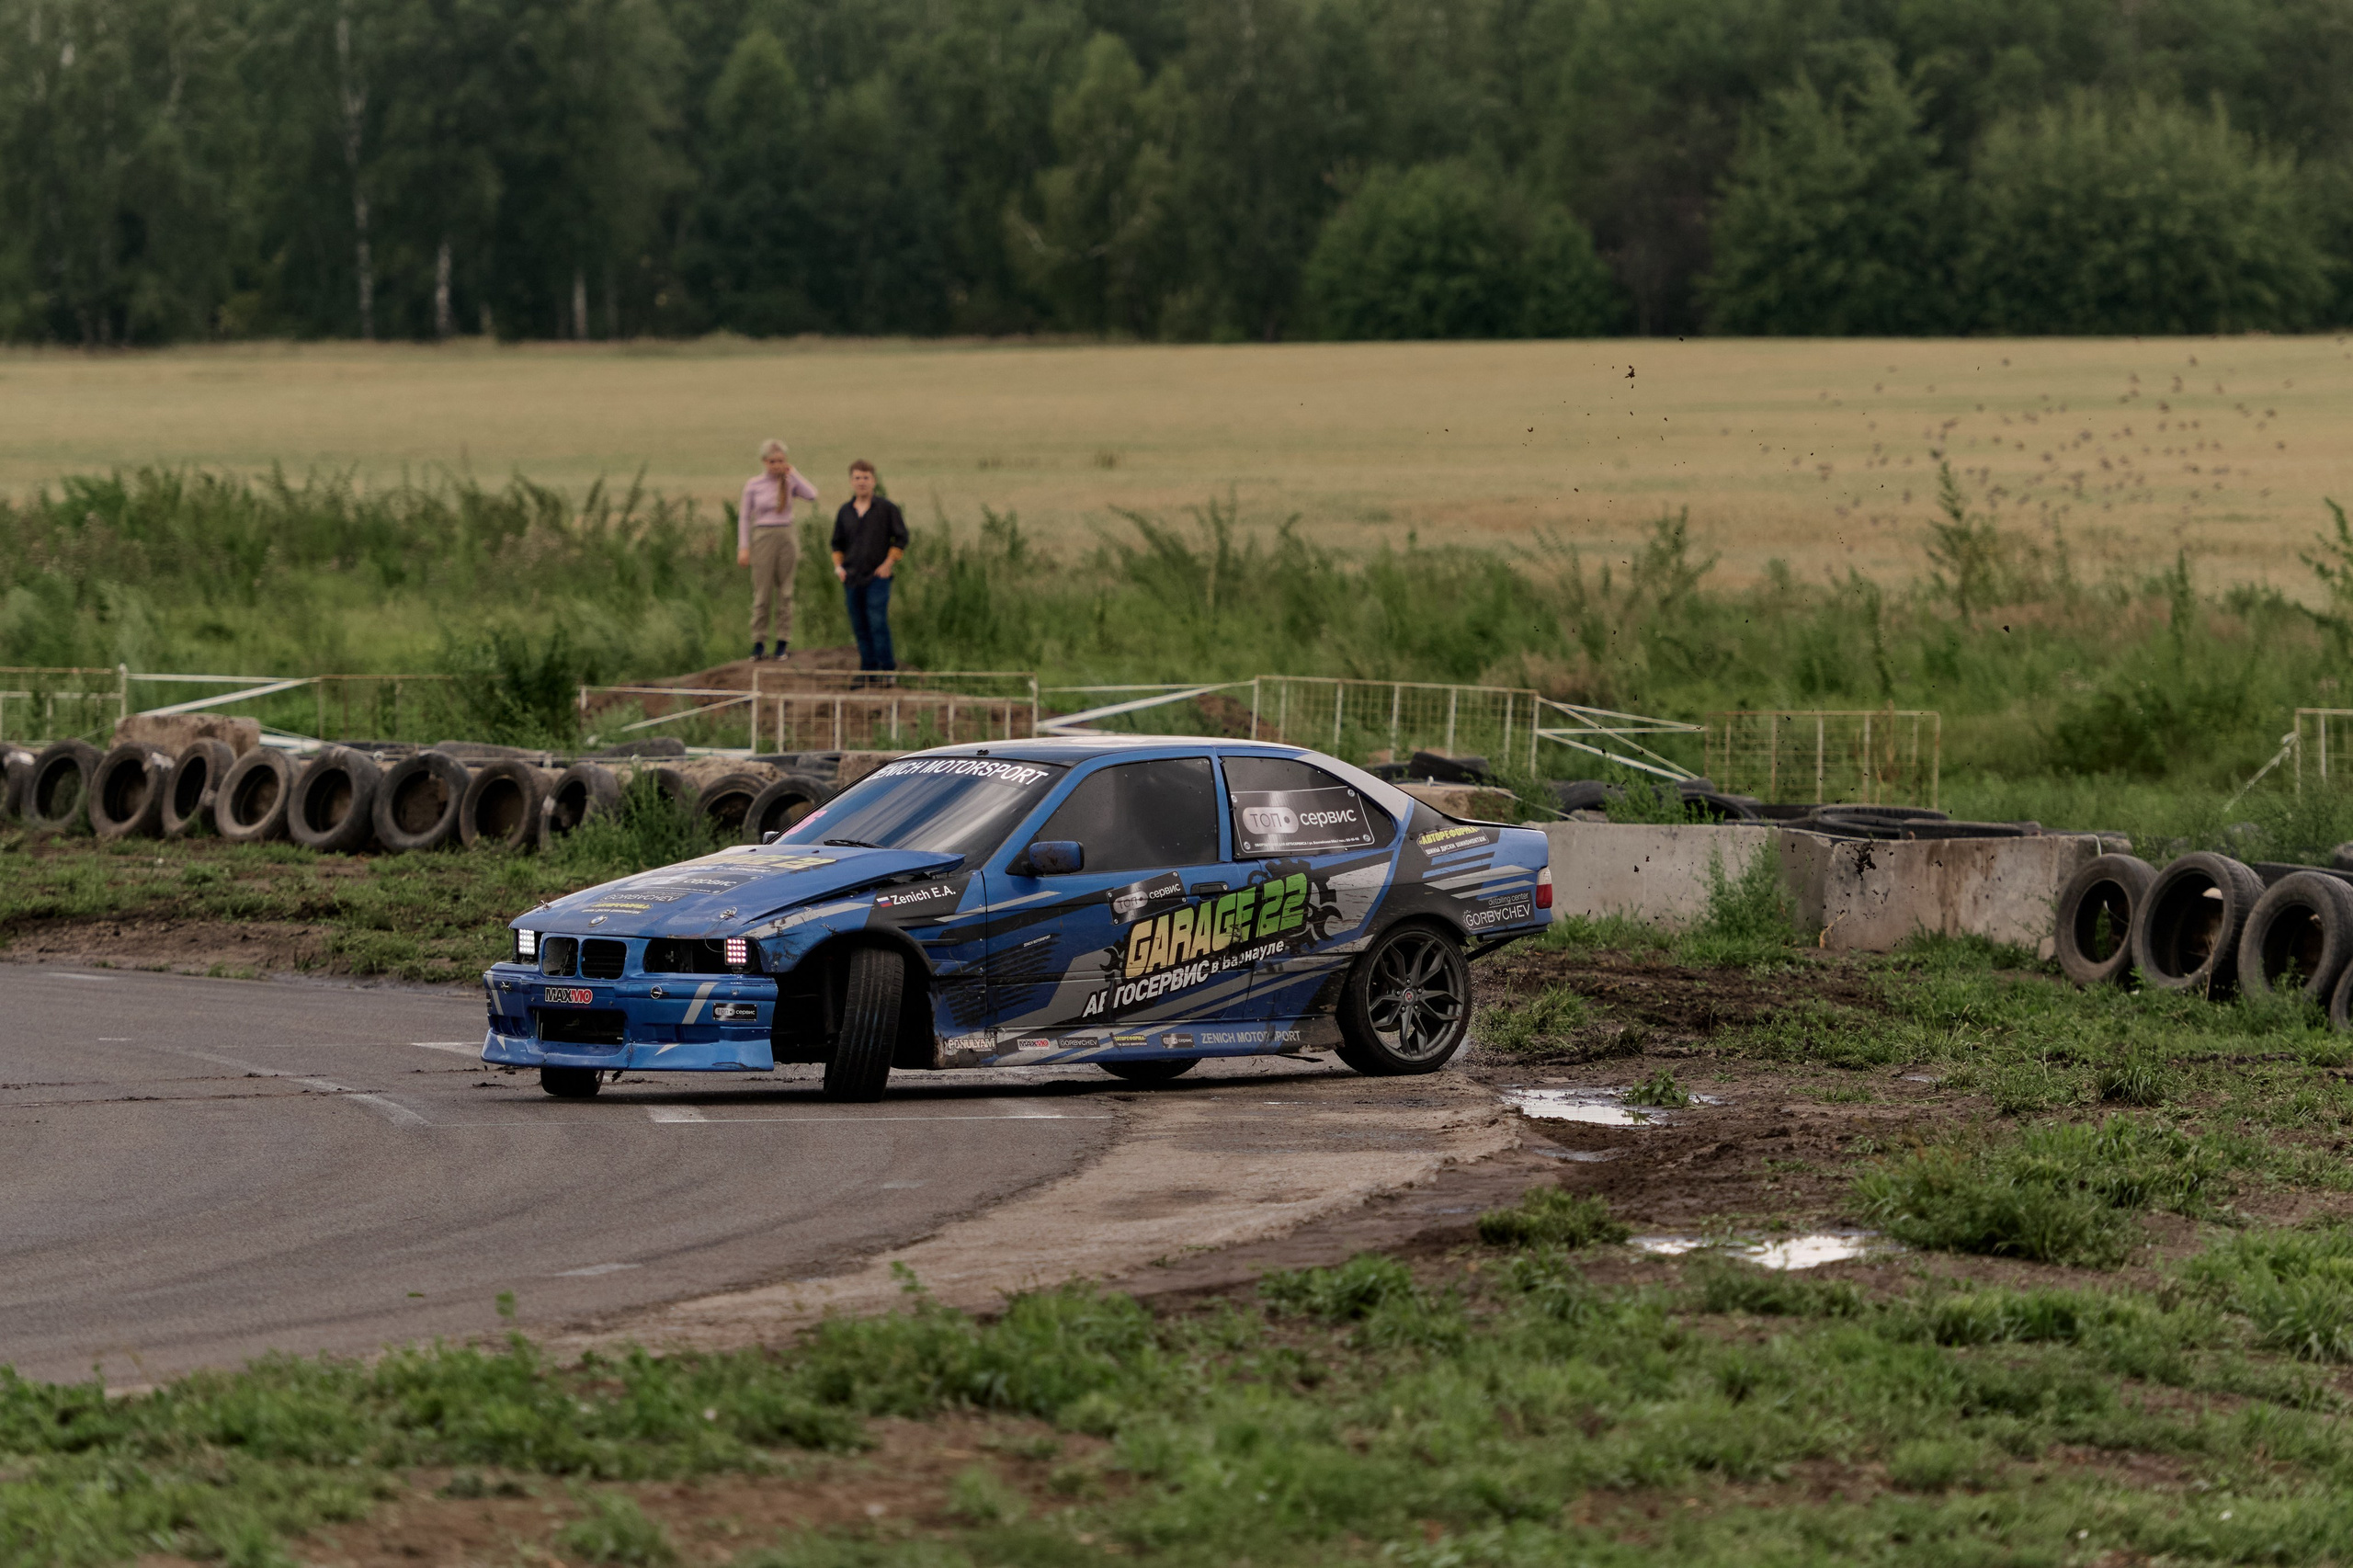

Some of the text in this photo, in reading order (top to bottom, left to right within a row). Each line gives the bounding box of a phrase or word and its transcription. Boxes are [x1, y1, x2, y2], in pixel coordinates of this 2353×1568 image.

[869, 759, 1049, 786] ENICH MOTORSPORT
[1300, 809, 1358, 828] сервис
[890, 885, 957, 905] Zenich E.A.
[1149, 883, 1181, 900] сервис
[1489, 892, 1529, 906] detailing center
[1125, 872, 1308, 979] GARAGE 22
[1211, 960, 1220, 973] в
[545, 987, 594, 1005] MAXMO
[1201, 1030, 1301, 1044] ZENICH MOTOPORT
